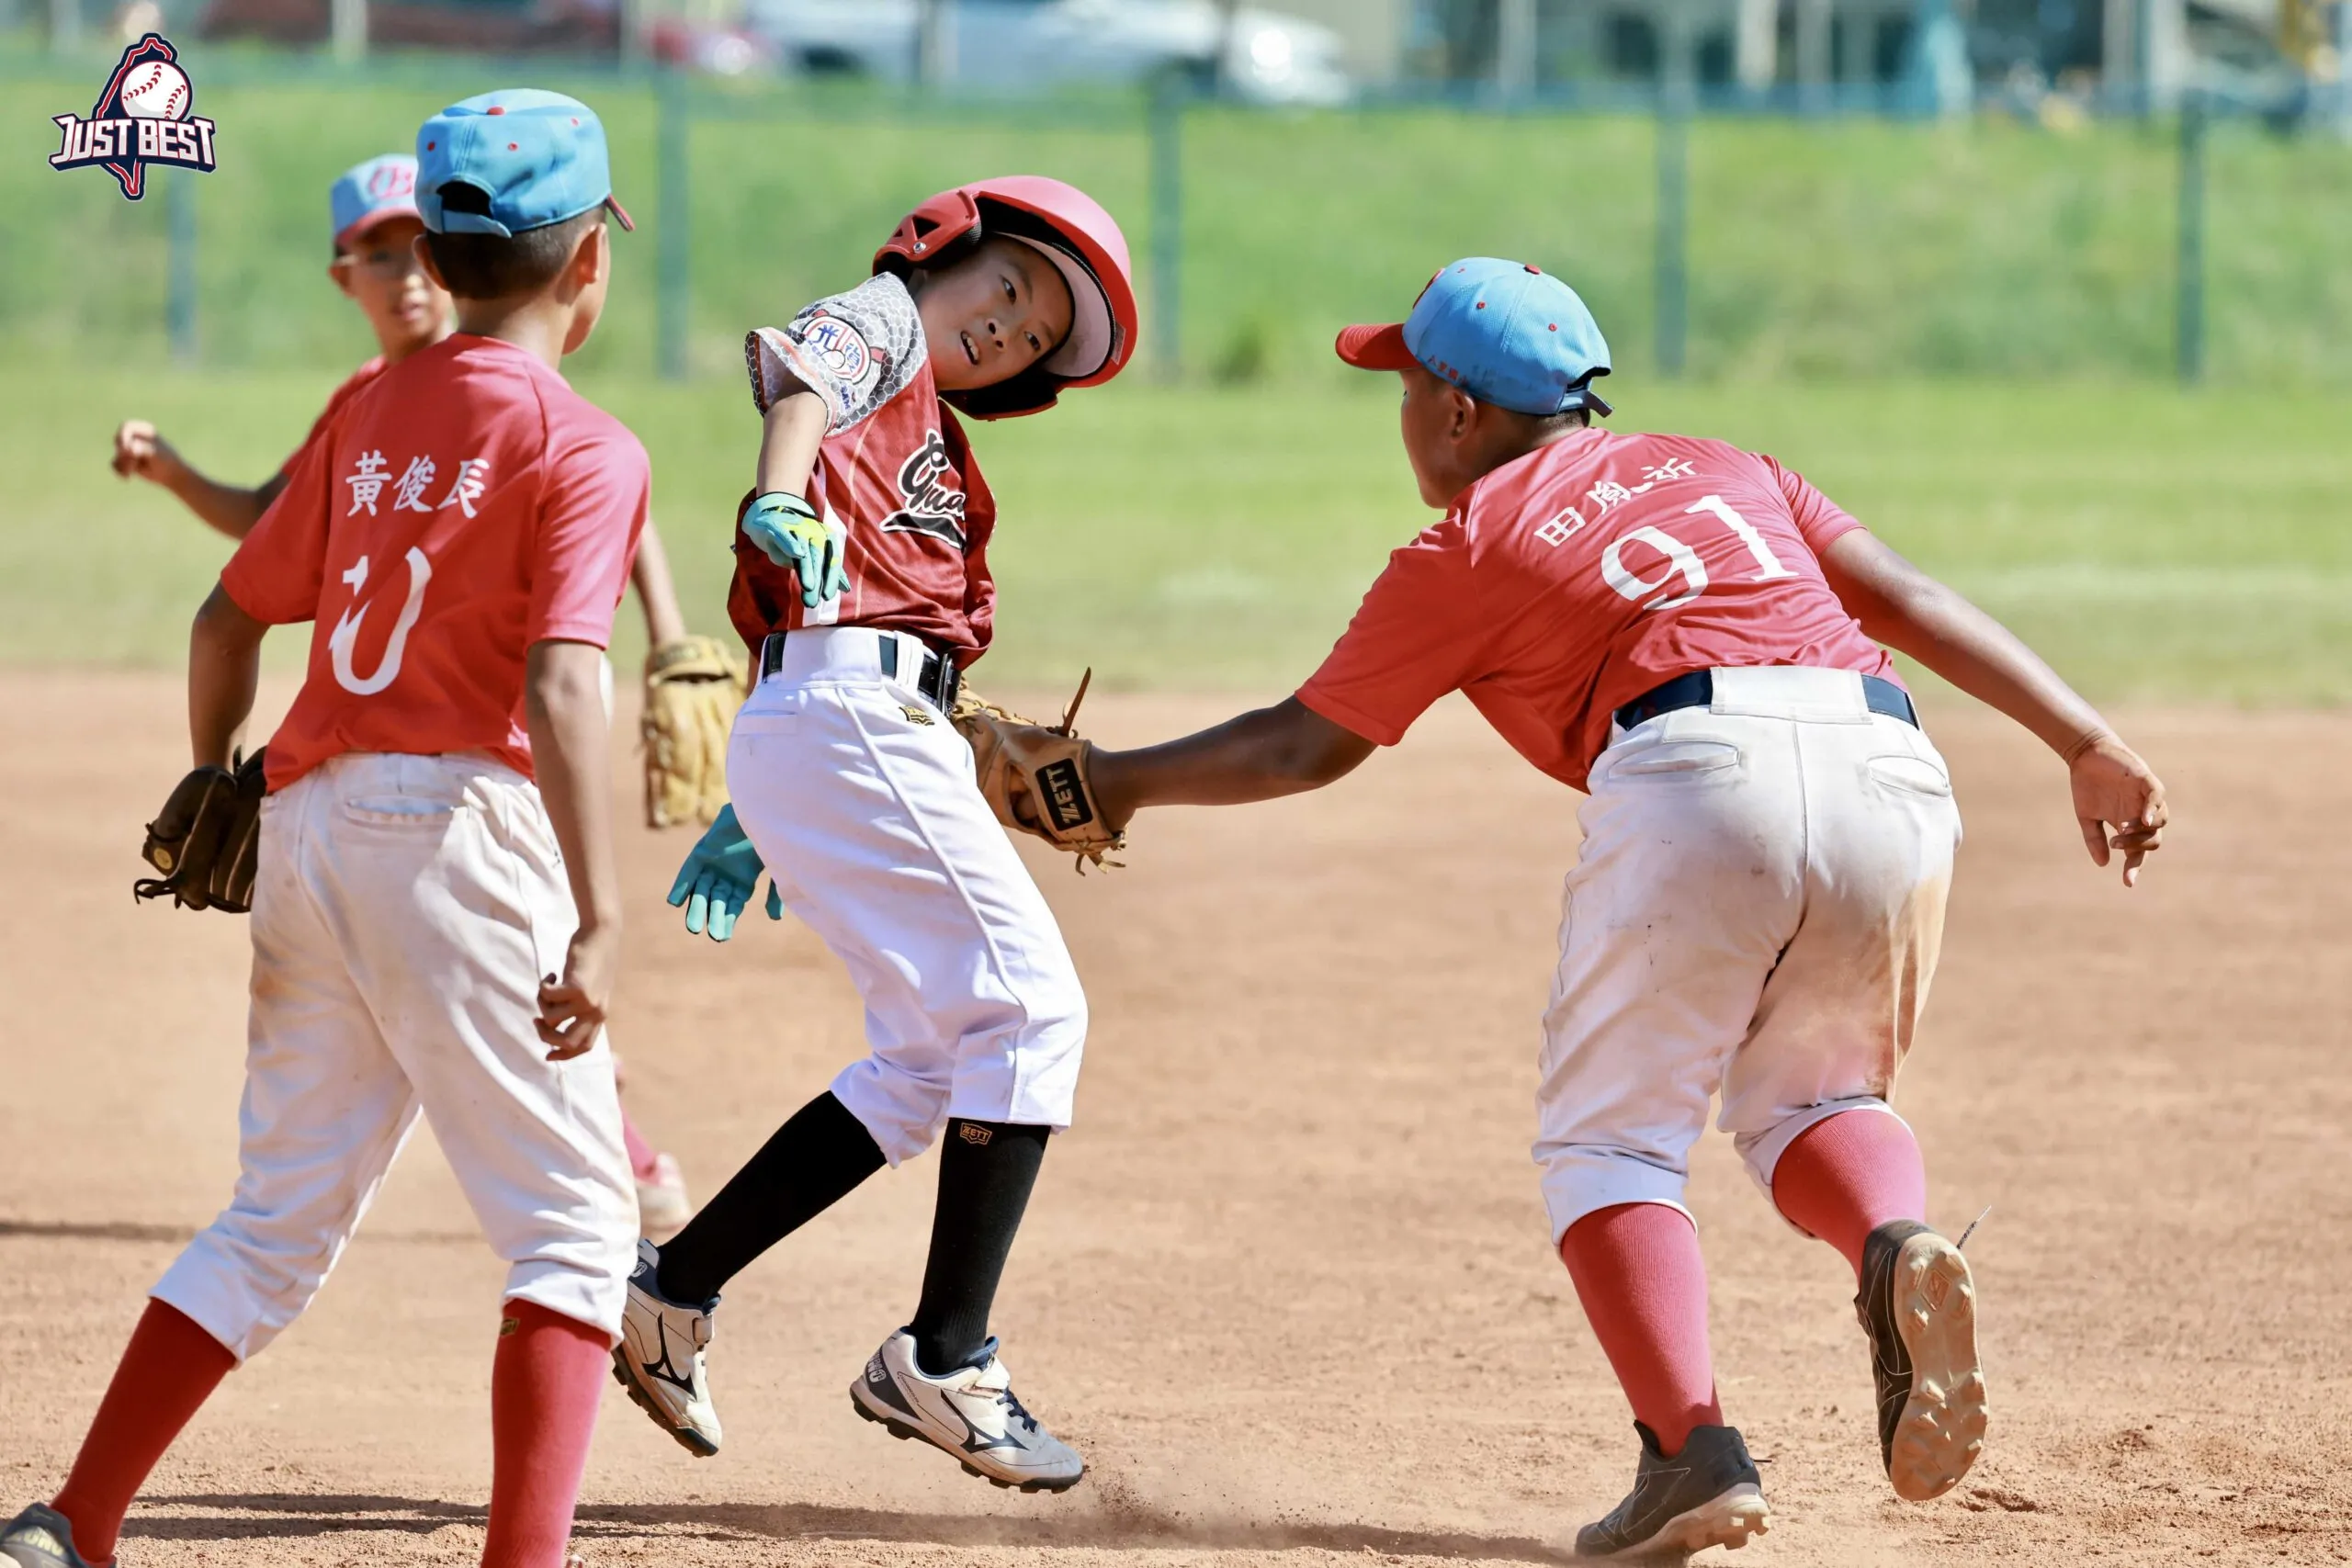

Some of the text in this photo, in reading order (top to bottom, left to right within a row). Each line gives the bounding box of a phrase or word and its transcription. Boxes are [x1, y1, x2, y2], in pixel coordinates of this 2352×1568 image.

[345, 449, 491, 519] 黃俊辰
[1600, 494, 1800, 611] 91
[1046, 767, 1081, 824] ZETT
[962, 1125, 989, 1141] ZETT
